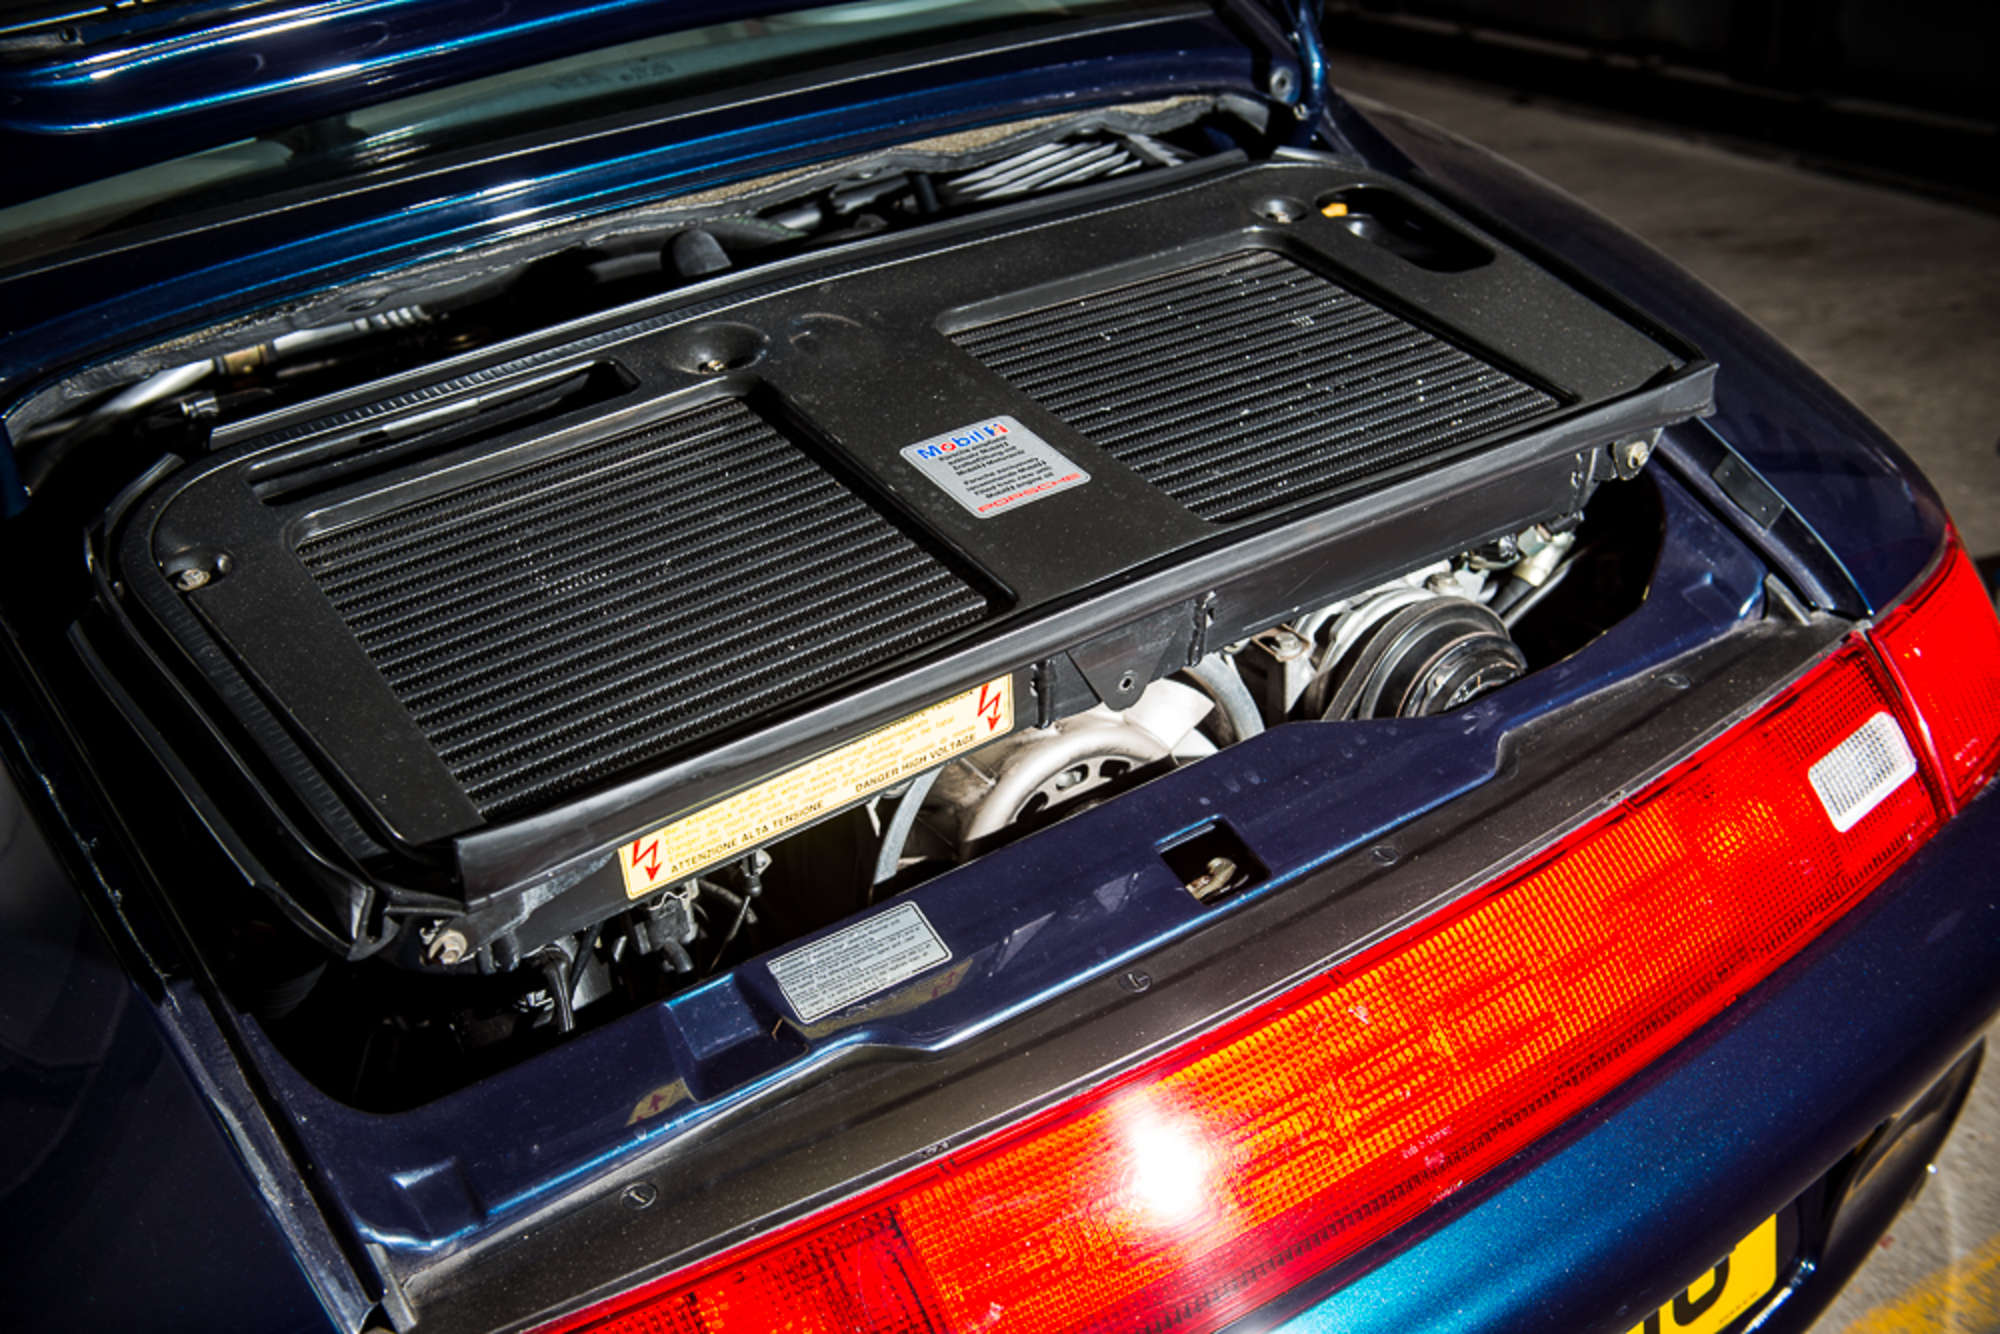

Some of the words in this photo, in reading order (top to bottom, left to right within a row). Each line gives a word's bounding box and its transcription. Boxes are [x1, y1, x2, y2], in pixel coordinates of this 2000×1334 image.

[917, 429, 985, 459] Mobil
[977, 473, 1081, 512] PORSCHE
[671, 839, 737, 873] ATTENZIONE
[742, 824, 769, 843] ALTA
[773, 800, 824, 828] TENSIONE
[855, 766, 900, 793] DANGER
[902, 755, 928, 772] HIGH
[929, 733, 976, 760] VOLTAGE
